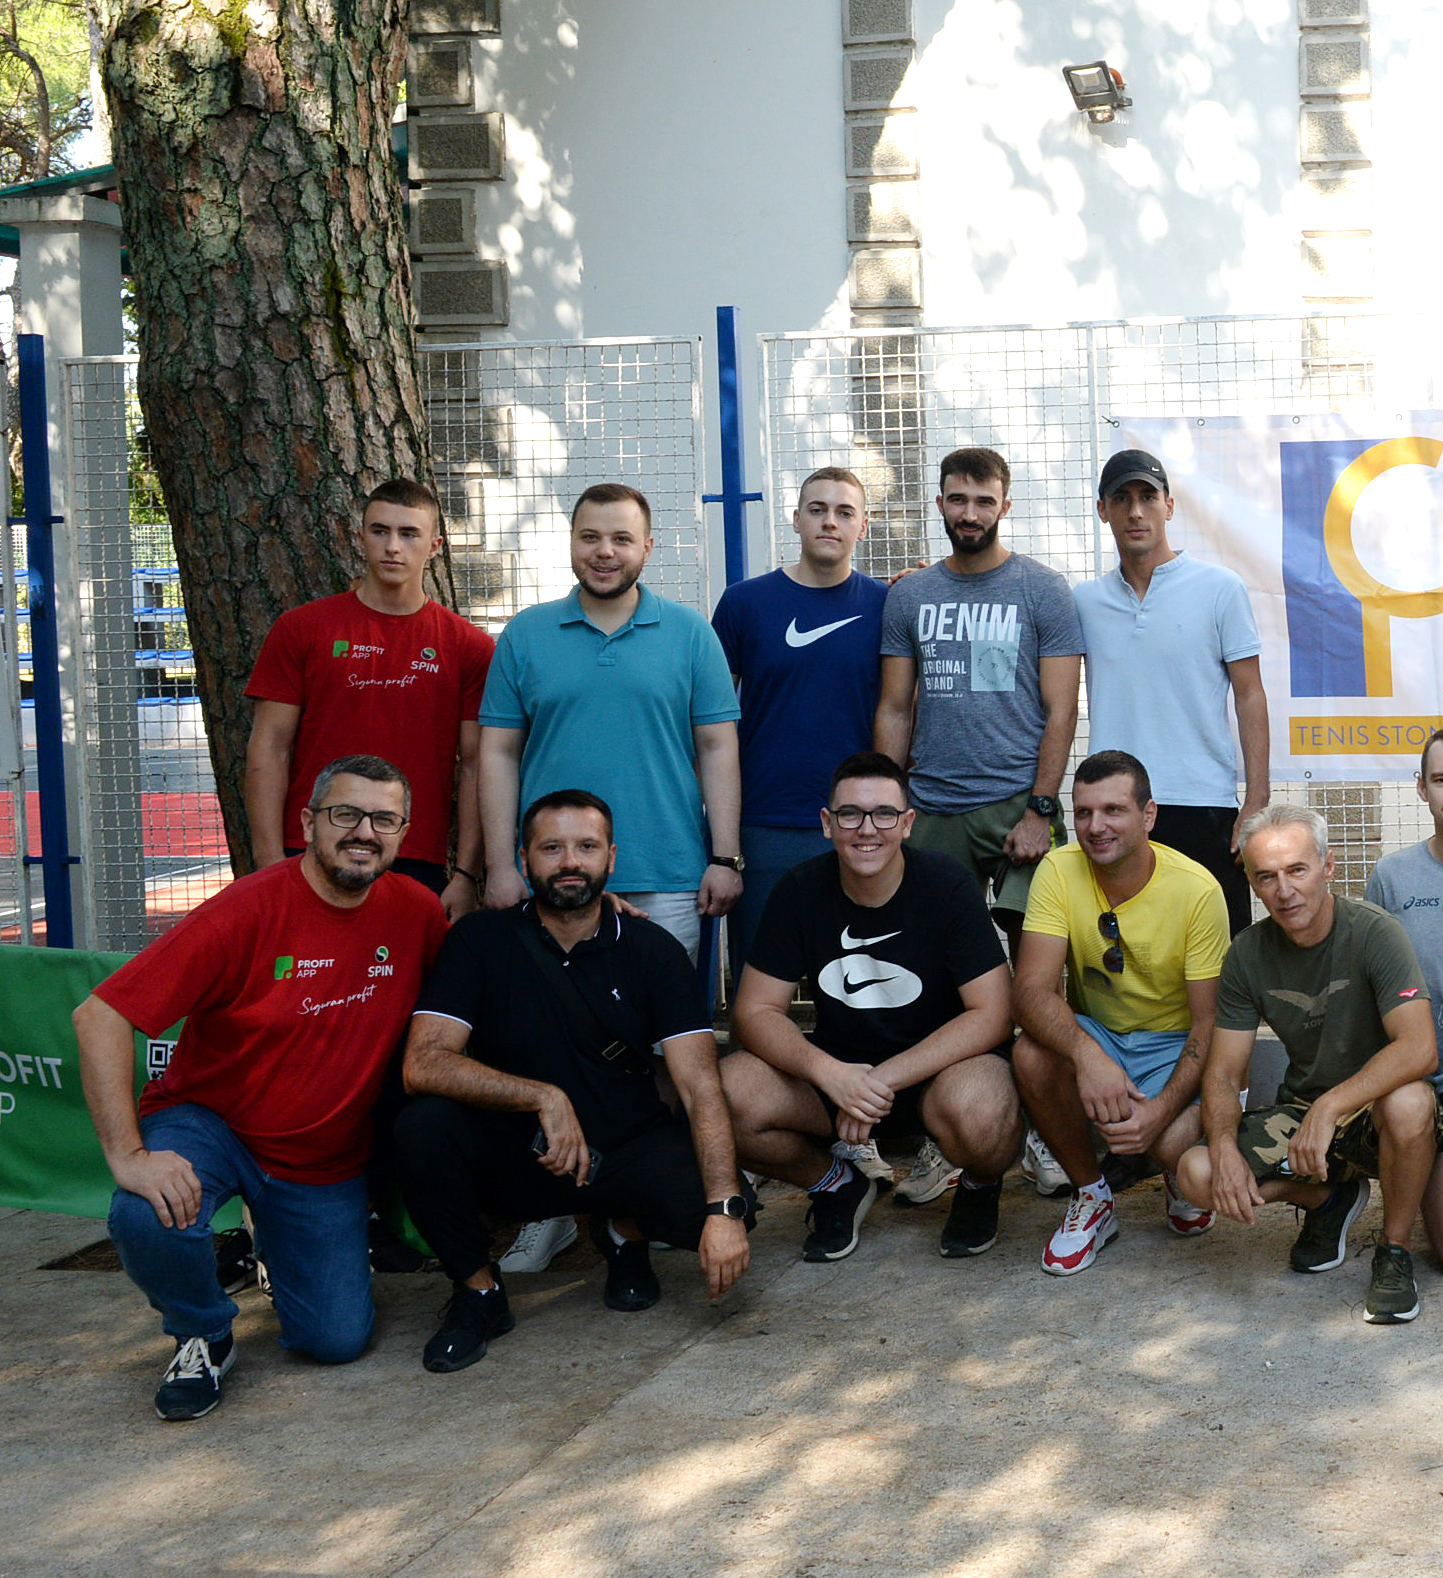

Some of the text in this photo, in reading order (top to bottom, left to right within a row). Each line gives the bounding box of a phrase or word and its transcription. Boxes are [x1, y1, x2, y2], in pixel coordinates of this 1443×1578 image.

[918, 603, 1018, 642] DENIM
[351, 652, 371, 660] APP
[353, 644, 385, 655] PROFIT
[920, 644, 937, 658] THE
[410, 660, 439, 674] SPIN
[384, 674, 419, 690] profit
[1296, 724, 1370, 747] TENIS
[297, 959, 335, 969] PROFIT
[367, 965, 394, 977] SPIN
[296, 969, 317, 978] APP
[345, 984, 378, 1007] profit
